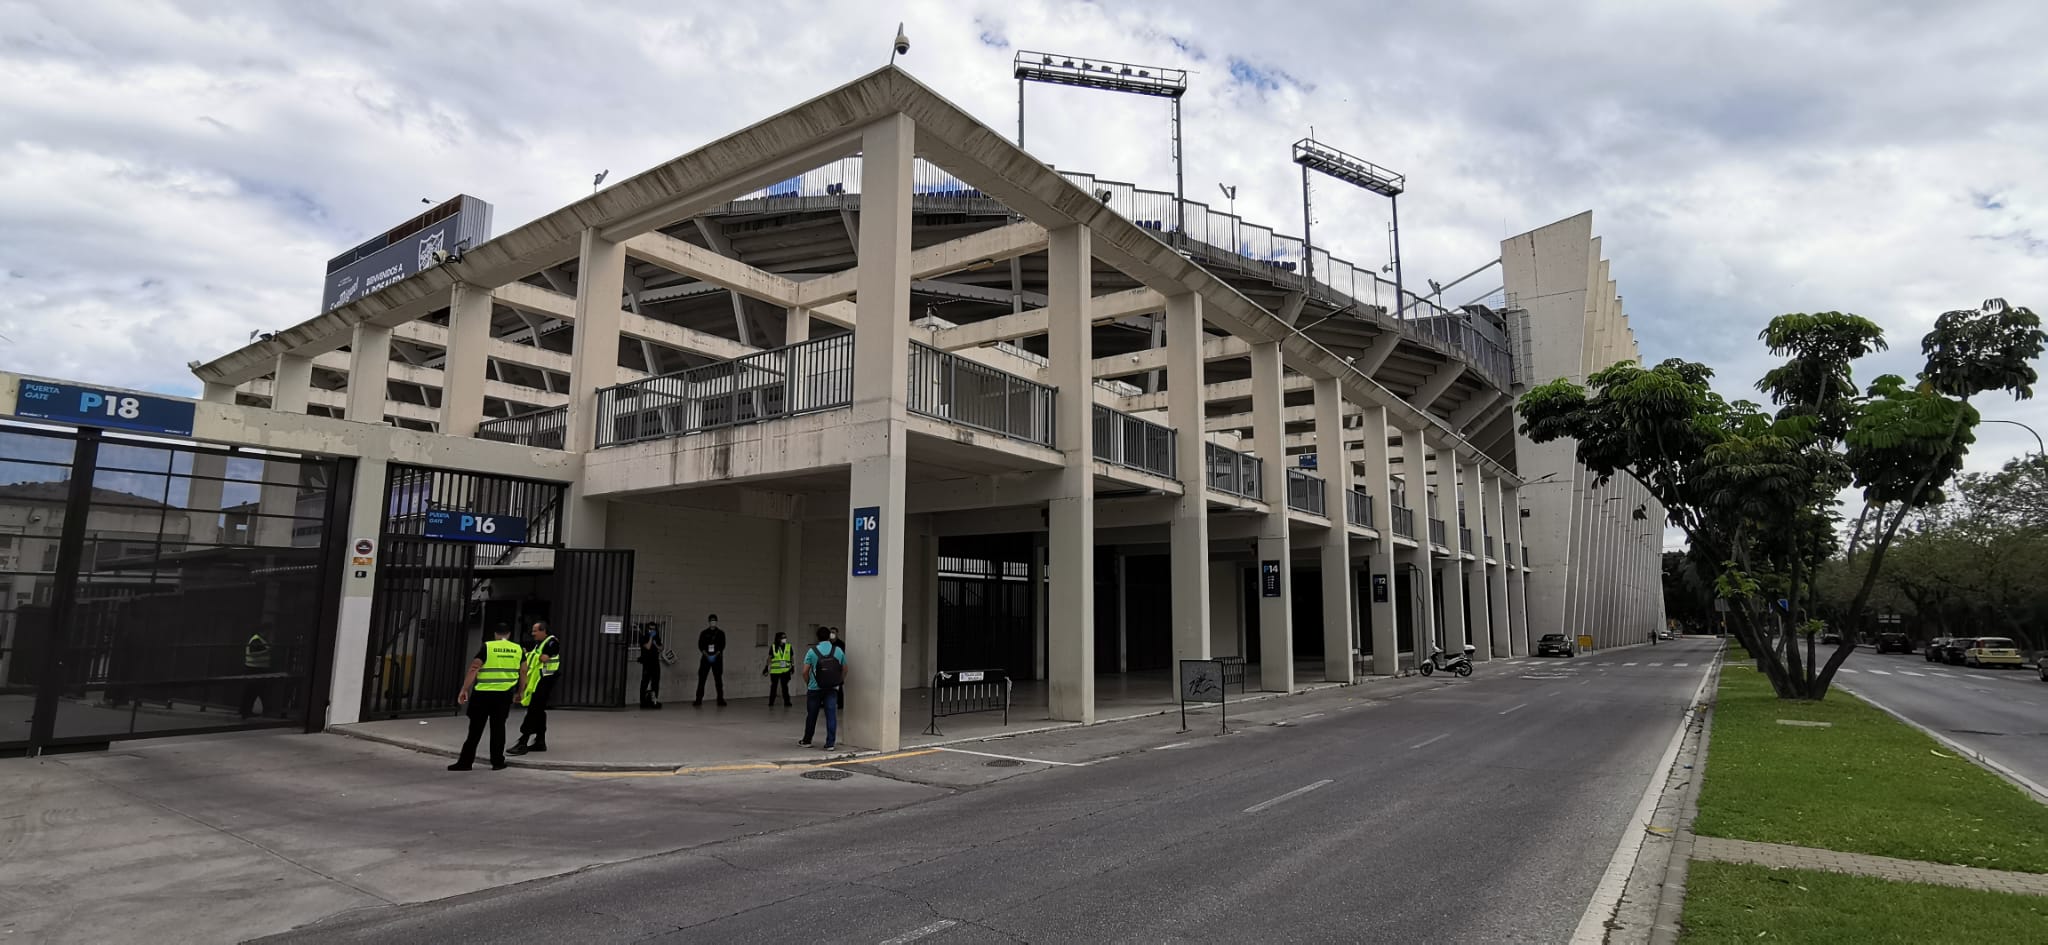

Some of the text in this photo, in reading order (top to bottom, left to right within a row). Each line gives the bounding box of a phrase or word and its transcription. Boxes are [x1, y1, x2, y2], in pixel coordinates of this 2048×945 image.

[25, 383, 60, 394] PUERTA
[24, 391, 50, 401] GATE
[79, 392, 139, 419] P18
[460, 515, 496, 534] P16
[855, 516, 876, 530] P16
[1263, 564, 1278, 573] P14
